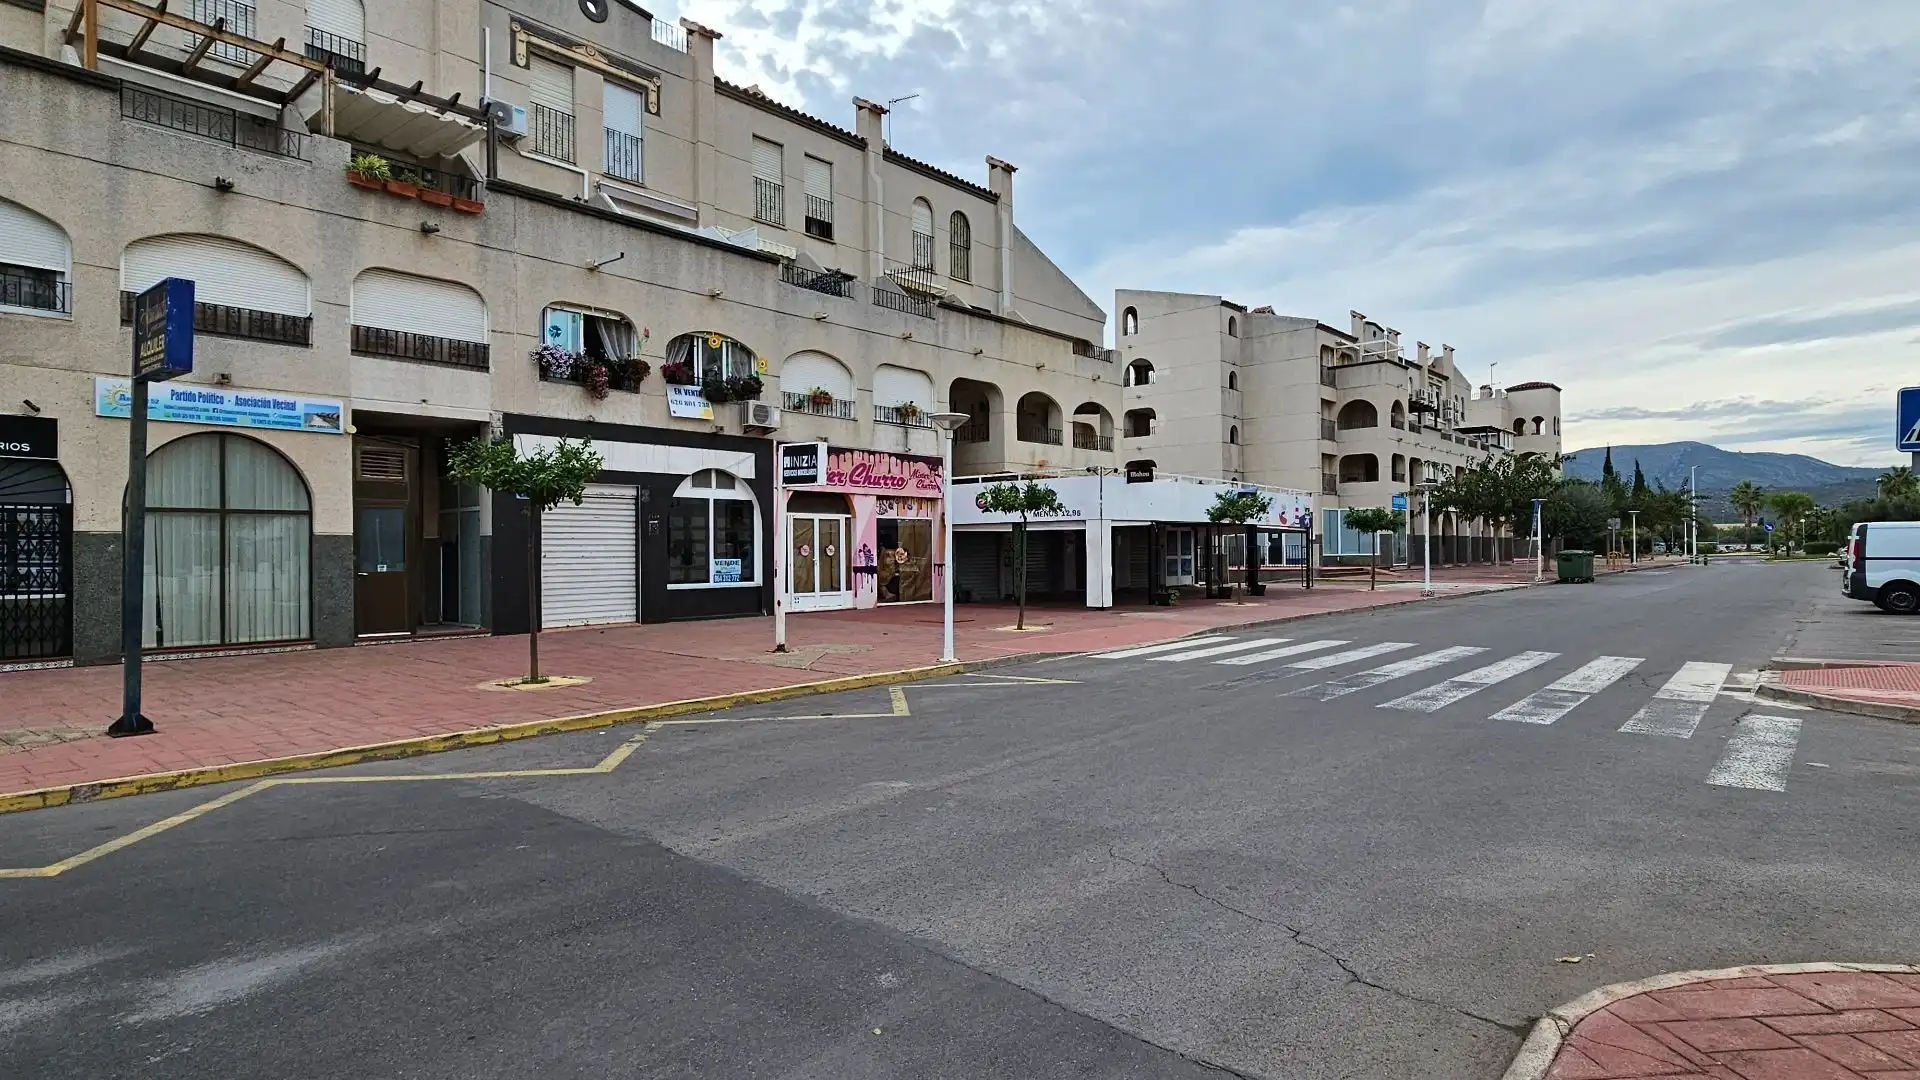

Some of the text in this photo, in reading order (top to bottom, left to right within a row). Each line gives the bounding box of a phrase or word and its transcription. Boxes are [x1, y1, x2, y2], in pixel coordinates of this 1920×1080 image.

[170, 389, 196, 403] Partido
[198, 391, 224, 405] Político
[235, 395, 271, 410] Asociación
[272, 398, 296, 411] Vecinal
[674, 387, 683, 396] EN
[826, 469, 846, 485] er
[849, 462, 907, 489] Churro
